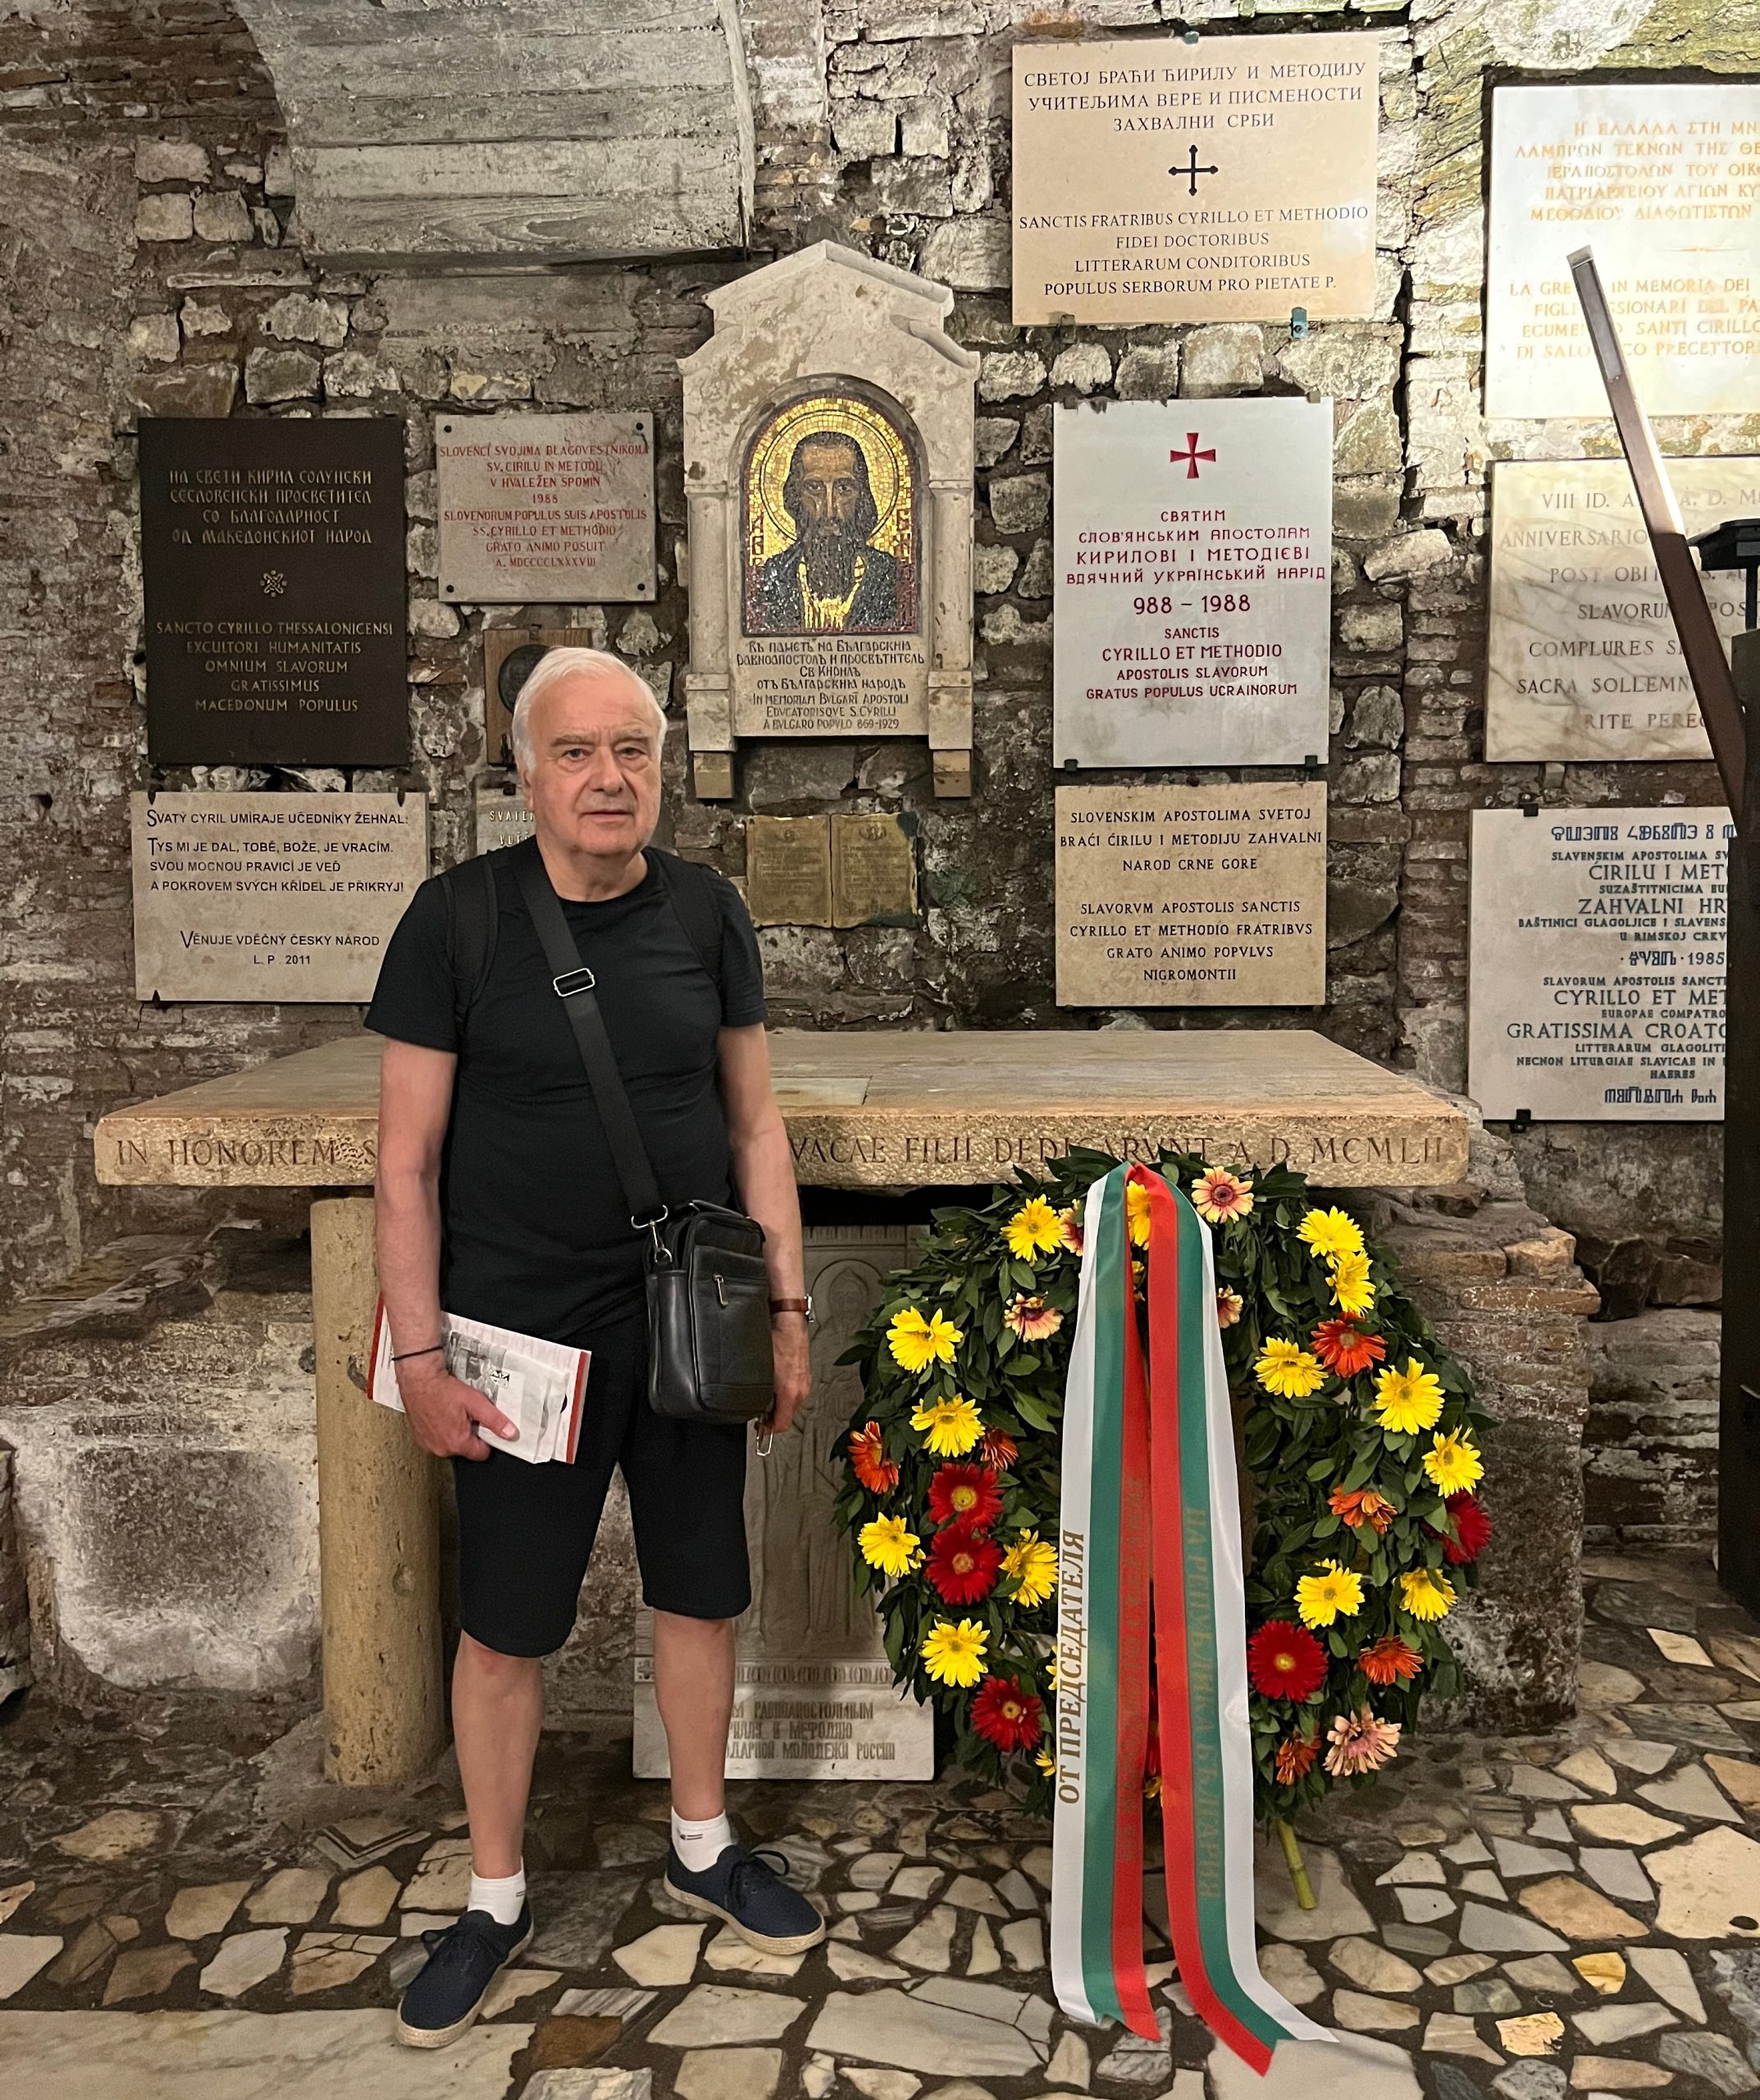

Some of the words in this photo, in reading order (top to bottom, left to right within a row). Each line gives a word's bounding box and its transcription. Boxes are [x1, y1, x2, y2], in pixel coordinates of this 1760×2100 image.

[1025, 72, 1088, 86] СВЕТОЈ
[1100, 70, 1154, 84] БРАЋИ
[1162, 67, 1236, 81] ЋИРИЛУ
[1248, 66, 1258, 79] И
[1271, 63, 1365, 79] МЕТОДИЈУ
[1029, 95, 1148, 111] УЧИТЕЉИМА
[1158, 93, 1200, 106] ВЕРЕ
[1211, 92, 1220, 104] И
[1229, 88, 1361, 103] ПИСМЕНОСТИ
[1115, 116, 1214, 131] ЗАХВАЛНИ
[1228, 114, 1273, 127] СРБИ
[1020, 216, 1086, 228] SANCTIS
[1092, 213, 1172, 226] FRATRIBUS
[1179, 212, 1248, 224] CYRILLO
[1256, 210, 1274, 221] ET
[1280, 207, 1367, 221] METHODIO
[1117, 236, 1157, 249] FIDEI
[1165, 233, 1268, 247] DOCTORIBUS
[1076, 258, 1179, 272] LITTERARUM
[1187, 255, 1309, 269] CONDITORIBUS
[1046, 282, 1116, 294] POPULUS
[1123, 280, 1211, 293] SERBORUM
[1220, 279, 1249, 290] PRO
[1256, 277, 1318, 290] PIETATE
[1326, 276, 1336, 287] P.
[1612, 281, 1627, 293] IN
[1636, 280, 1714, 294] MEMORIA
[1724, 279, 1750, 291] DEI
[490, 478, 496, 486] V
[503, 475, 556, 487] HVALEŽEN
[562, 476, 600, 486] SPOMIN
[533, 494, 558, 504] 1988
[1543, 494, 1575, 509] VIII
[1586, 493, 1610, 508] ID.
[445, 511, 512, 520] SLOVENORUM
[515, 511, 560, 520] POPULUS
[564, 510, 586, 519] SUIS
[590, 509, 646, 519] APOSTOLIS
[1161, 510, 1224, 522] СВЯТИМ
[1211, 527, 1309, 540] АПОСТОЛАМ
[1501, 530, 1648, 547] ANNIVERSARIO
[486, 541, 521, 552] GRATO
[527, 542, 559, 552] ANIMO
[564, 541, 602, 551] POSUIT
[1078, 550, 1175, 564] КИРИЛОВІ
[1208, 547, 1308, 561] МЕТОДІЄВІ
[1067, 568, 1142, 584] ВДЯЧНИЙ
[1154, 565, 1265, 584] УКРАЇНСЬКИЙ
[1278, 568, 1325, 579] НАРІД
[1550, 567, 1599, 583] POST
[1134, 597, 1172, 614] 988
[1201, 595, 1250, 612] 1988
[157, 622, 213, 633] SANCTO
[218, 623, 272, 633] CYRILLO
[280, 623, 392, 634] THESSALONICENSI
[1165, 628, 1219, 639] SANCTIS
[188, 641, 258, 653] EXCULTORI
[270, 641, 361, 653] HUMANITATIS
[1103, 647, 1170, 661] CYRILLO
[1177, 646, 1195, 659] ET
[1201, 645, 1281, 658] METHODIO
[1530, 641, 1653, 657] COMPLURES
[206, 660, 266, 672] OMNIUM
[277, 661, 347, 673] SLAVORUM
[1117, 669, 1188, 680] APOSTOLIS
[1196, 666, 1267, 678] SLAVORUM
[232, 680, 319, 692] GRATISSIMUS
[1087, 688, 1138, 699] GRATUS
[1145, 687, 1203, 697] POPULUS
[1210, 684, 1297, 696] UCRAINORUM
[1517, 678, 1576, 694] SACRA
[196, 700, 287, 710] MACEDONUM
[299, 700, 358, 711] POPULUS
[764, 719, 769, 729] A
[773, 719, 814, 728] BVLGARO
[818, 719, 852, 728] POPVLO
[1584, 714, 1633, 729] RITE
[191, 814, 226, 823] CYRIL
[230, 814, 284, 823] UMÍRAJE
[289, 812, 351, 824] UČEDNÍKY
[355, 812, 408, 824] ŽEHNAL:
[1071, 811, 1155, 823] SLOVENSKIM
[1164, 810, 1250, 821] APOSTOLIMA
[1259, 809, 1310, 819] SVETOJ
[1061, 833, 1099, 847] BRAĆI
[1108, 833, 1151, 846] ĆIRILU
[1160, 835, 1163, 845] I
[1172, 833, 1239, 845] METODIJU
[1248, 833, 1320, 843] ZAHVALNI
[1552, 851, 1624, 861] SLAVENSKIM
[1632, 851, 1707, 861] APOSTOLIMA
[1124, 860, 1170, 870] NAROD
[1179, 859, 1214, 870] CRNE
[1222, 859, 1256, 869] GORE
[1589, 861, 1655, 879] ĆIRILU
[1666, 865, 1670, 879] I
[151, 881, 158, 890] A
[163, 882, 231, 891] POKROVEM
[236, 882, 276, 891] SVÝCH
[281, 880, 326, 891] KŘÍDEL
[330, 883, 344, 891] JE
[349, 883, 403, 892] PŘIKRYJ!
[1599, 883, 1703, 893] SUZAŠTITNICIMA
[1081, 903, 1152, 914] SLAVORVM
[1162, 902, 1233, 913] APOSTOLIS
[1242, 902, 1299, 912] SANCTIS
[1579, 898, 1683, 914] ZAHVALNI
[1519, 917, 1577, 927] BAŠTINICI
[1584, 918, 1656, 927] GLAGOLJICE
[1664, 918, 1667, 926] I
[1070, 926, 1126, 936] CYRILLO
[1135, 925, 1151, 935] ET
[1159, 924, 1229, 936] METHODIO
[1238, 924, 1311, 934] FRATRIBVS
[1107, 947, 1152, 958] GRATO
[1161, 947, 1206, 957] ANIMO
[1215, 947, 1273, 957] POPVLVS
[1688, 952, 1723, 965] 1985
[1144, 969, 1235, 980] NIGROMONTII
[1543, 977, 1606, 985] SLAVORUM
[1614, 977, 1675, 985] APOSTOLIS
[1554, 990, 1639, 1005] CYRILLO
[1653, 990, 1676, 1005] ET
[1602, 1010, 1653, 1018] EUROPAE
[1507, 1023, 1633, 1039] GRATISSIMA
[1575, 1043, 1651, 1052] LITTERARUM
[1651, 1070, 1694, 1079] HAERES
[117, 1140, 148, 1165] IN
[168, 1139, 335, 1166] HONOREM
[905, 1137, 972, 1163] FILII
[1313, 1138, 1443, 1164] MCMLII
[1059, 1531, 1087, 1759] ПРЕДСЕДАТЕЛЯ
[1187, 1554, 1215, 1731] РЕПУБЛИКА
[1058, 1763, 1080, 1804] ОТ
[1193, 1744, 1221, 1898] БЪЛГАРИЯ
